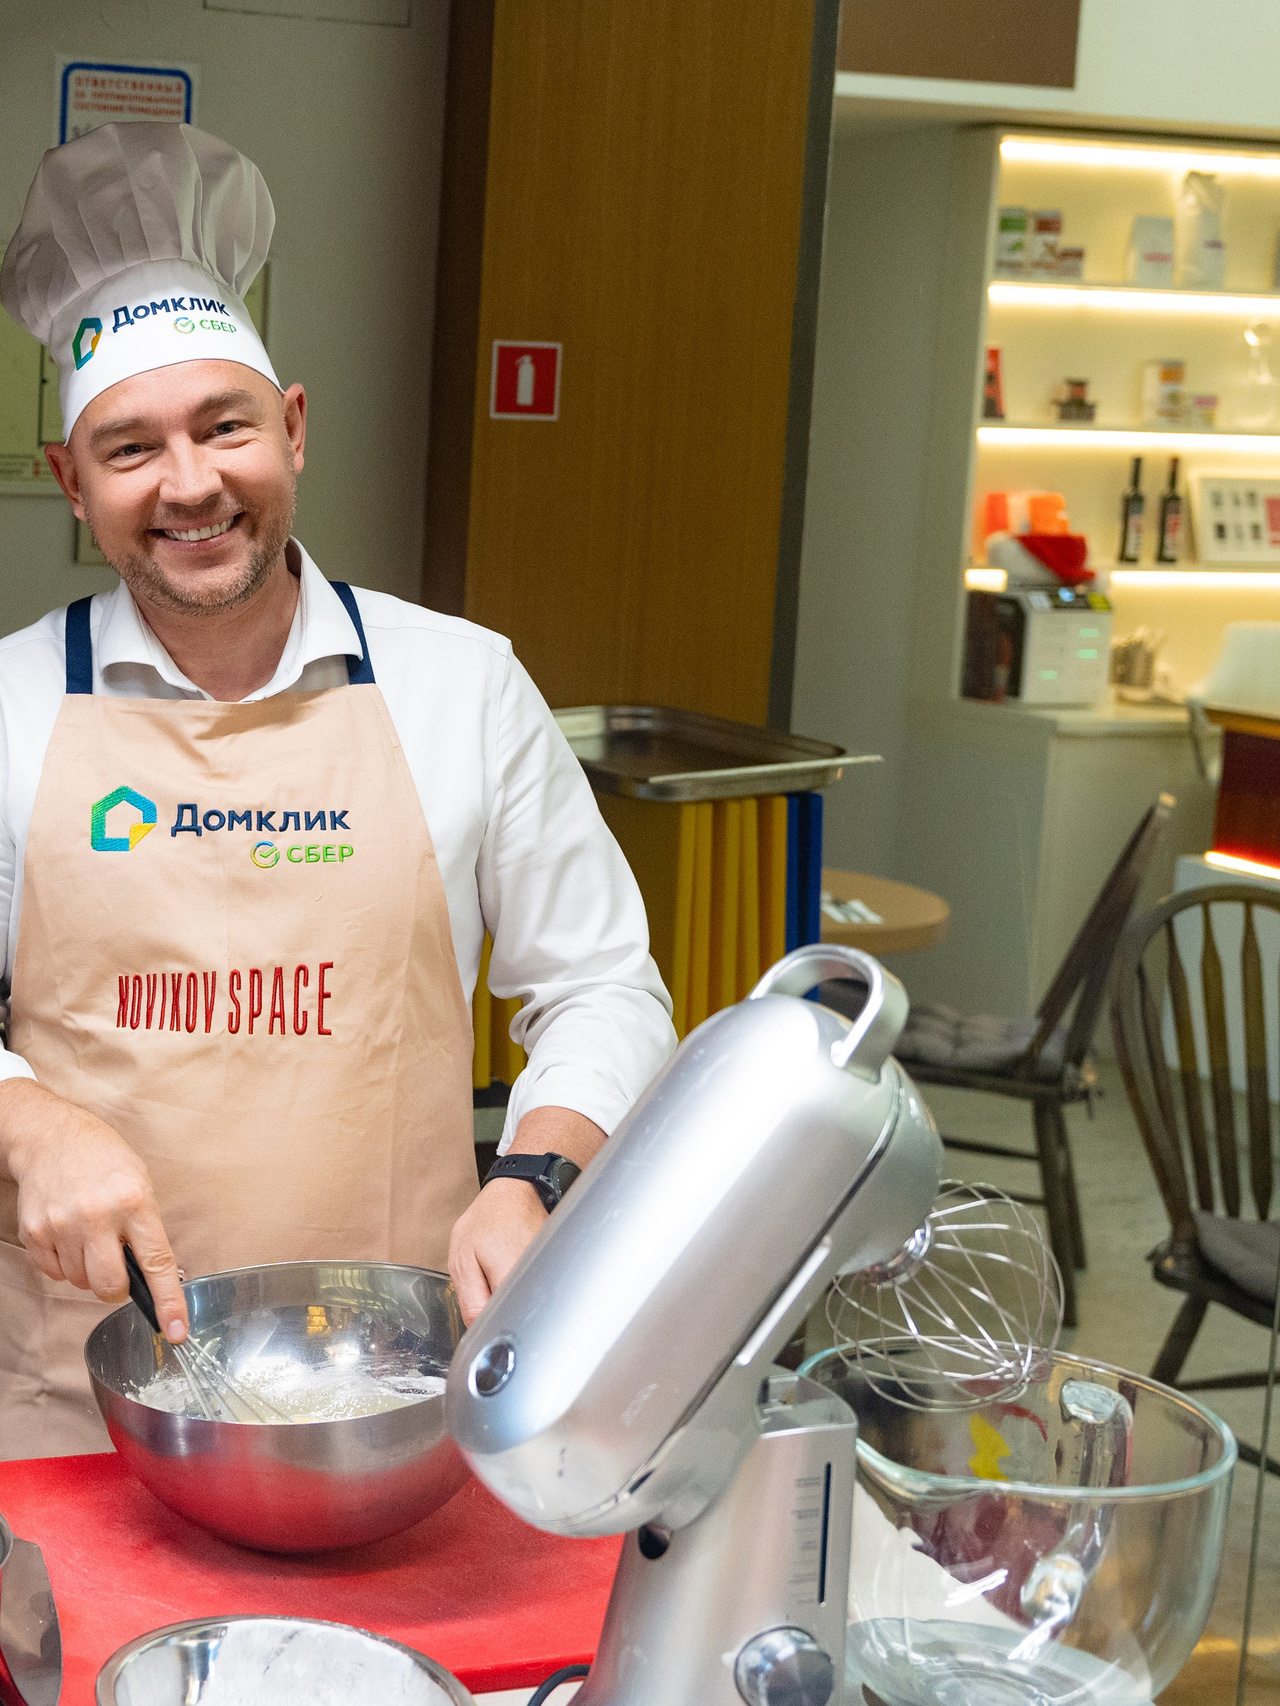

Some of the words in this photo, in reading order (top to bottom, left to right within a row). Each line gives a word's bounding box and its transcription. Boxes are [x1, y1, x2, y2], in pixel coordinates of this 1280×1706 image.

[199, 318, 237, 334] СБЕР
[286, 844, 354, 864] СБЕР
[116, 971, 217, 1034] NOVIKOV
[227, 961, 334, 1036] SPACE
